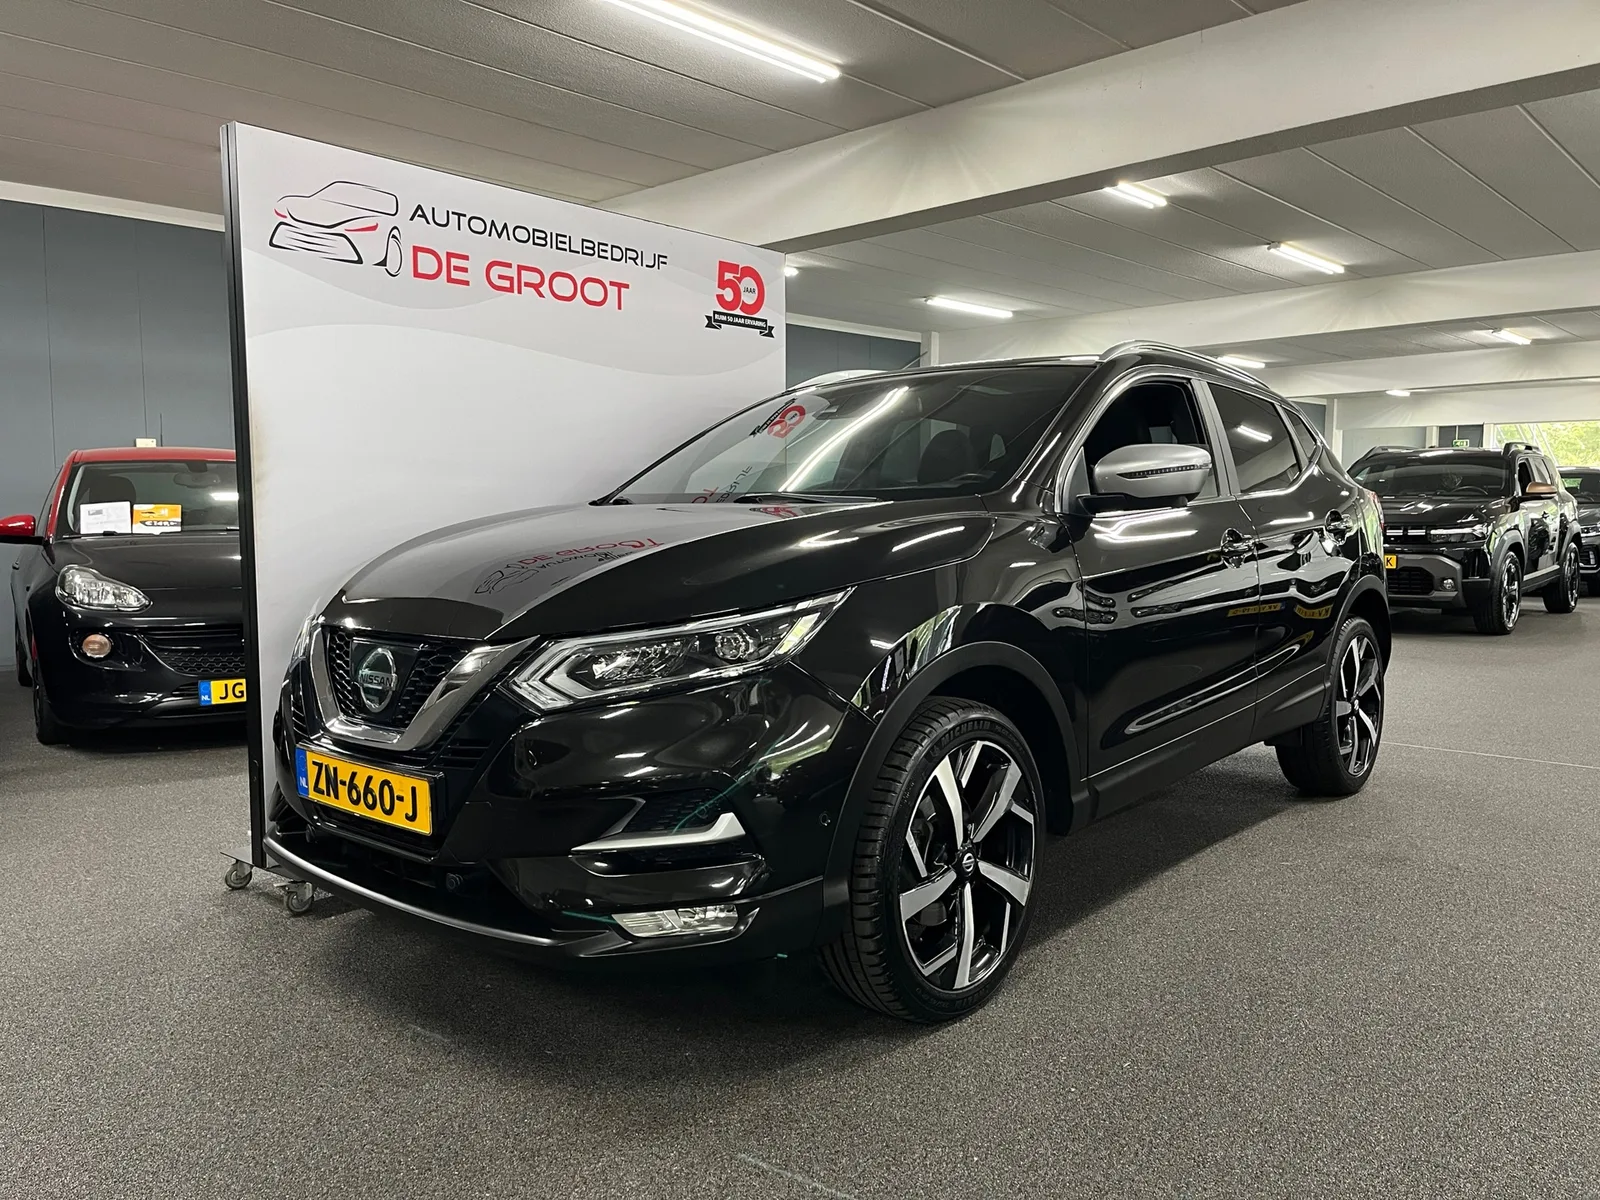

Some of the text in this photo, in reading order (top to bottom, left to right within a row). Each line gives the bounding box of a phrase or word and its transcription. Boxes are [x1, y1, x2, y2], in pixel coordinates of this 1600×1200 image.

[409, 204, 668, 270] AUTOMOBIELBEDRIJF
[412, 245, 630, 310] DE GROOT
[716, 260, 765, 315] 50
[743, 286, 756, 294] JAAR
[360, 673, 393, 687] NISSAN
[311, 760, 418, 822] ZN-660-J
